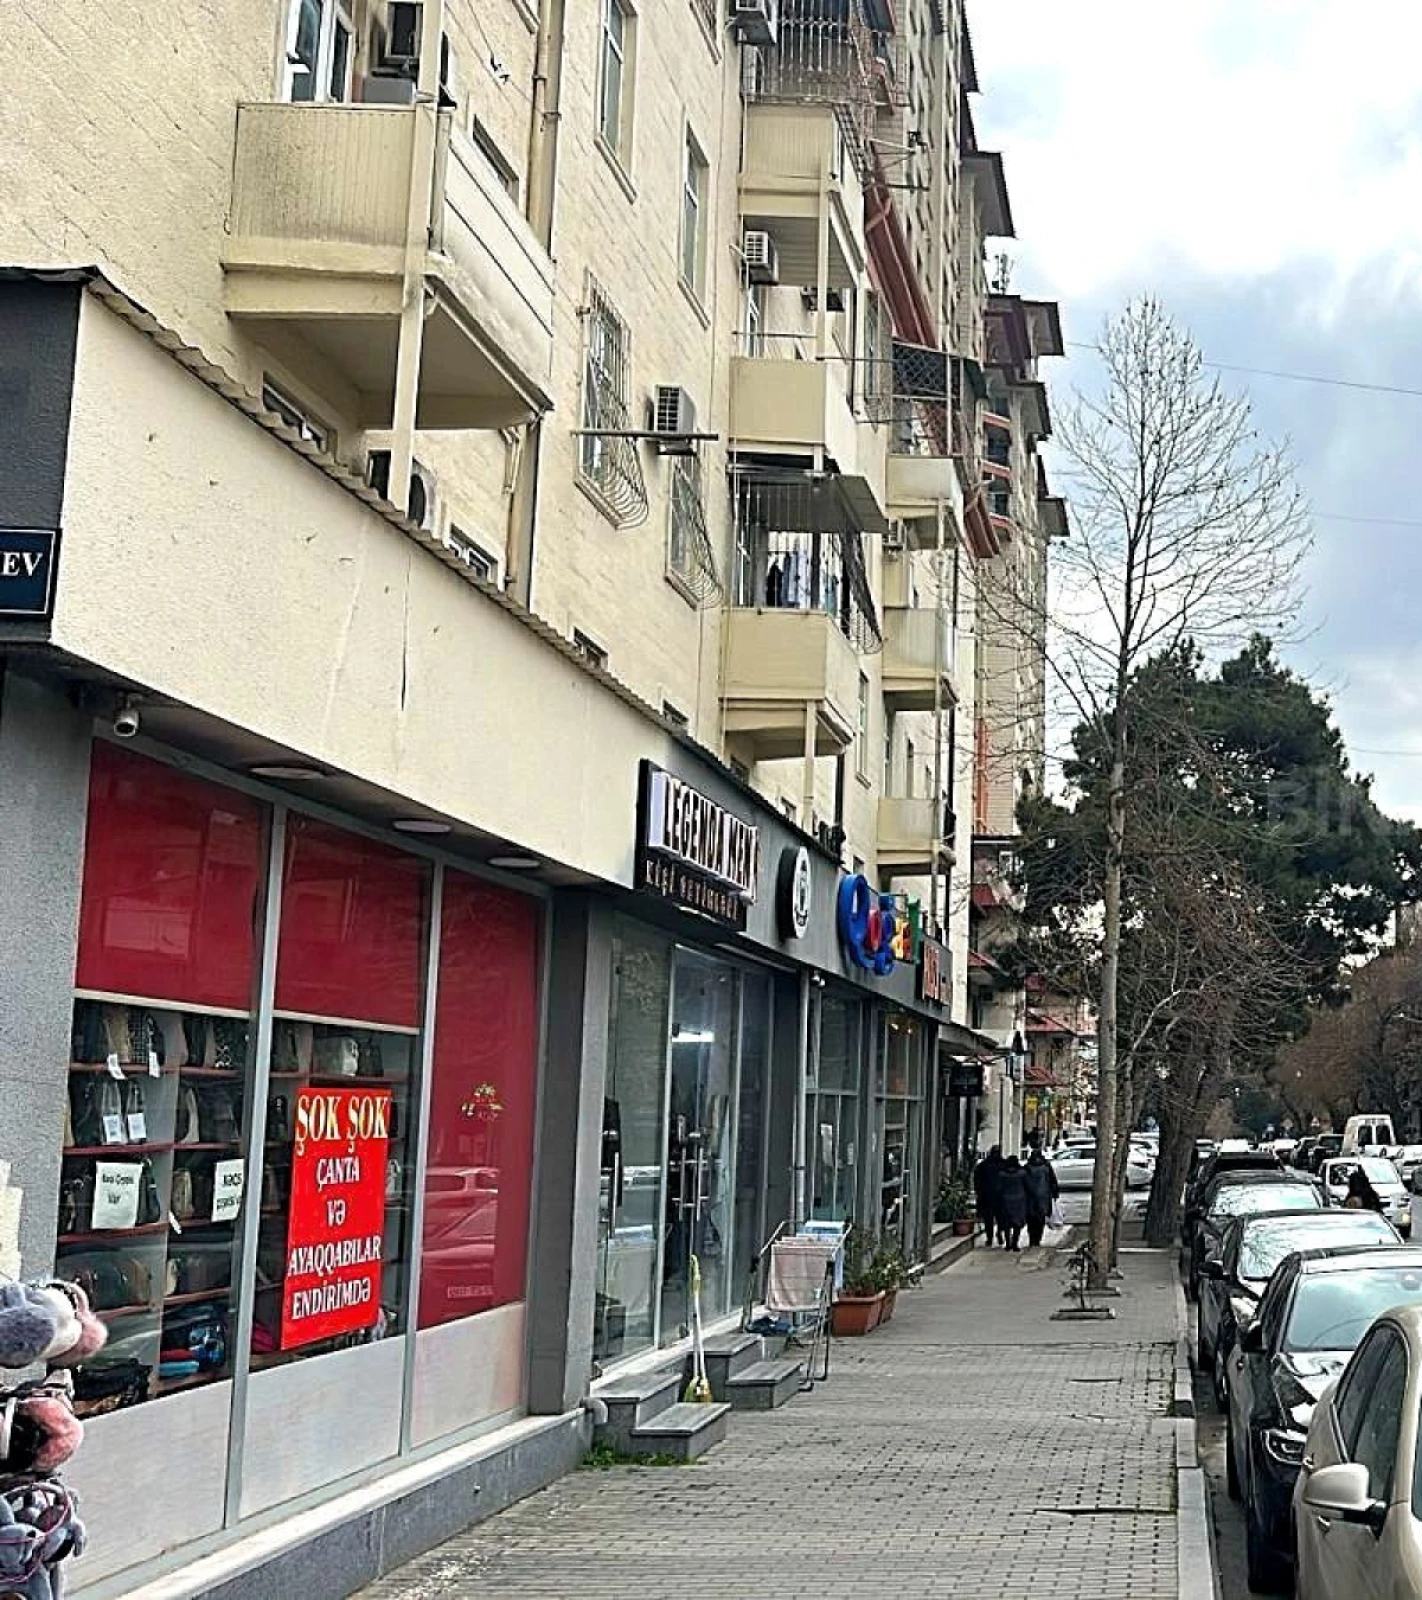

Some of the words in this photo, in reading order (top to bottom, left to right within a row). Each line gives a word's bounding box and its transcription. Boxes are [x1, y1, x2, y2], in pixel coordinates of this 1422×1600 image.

[650, 772, 724, 881] LEGENDA
[296, 1095, 342, 1156] ŞOK
[347, 1096, 389, 1153] ŞOK
[317, 1158, 359, 1191] ÇANTA
[288, 1235, 381, 1277] AYAQQABILAR
[291, 1276, 371, 1320] ENDİRİMDƏ
